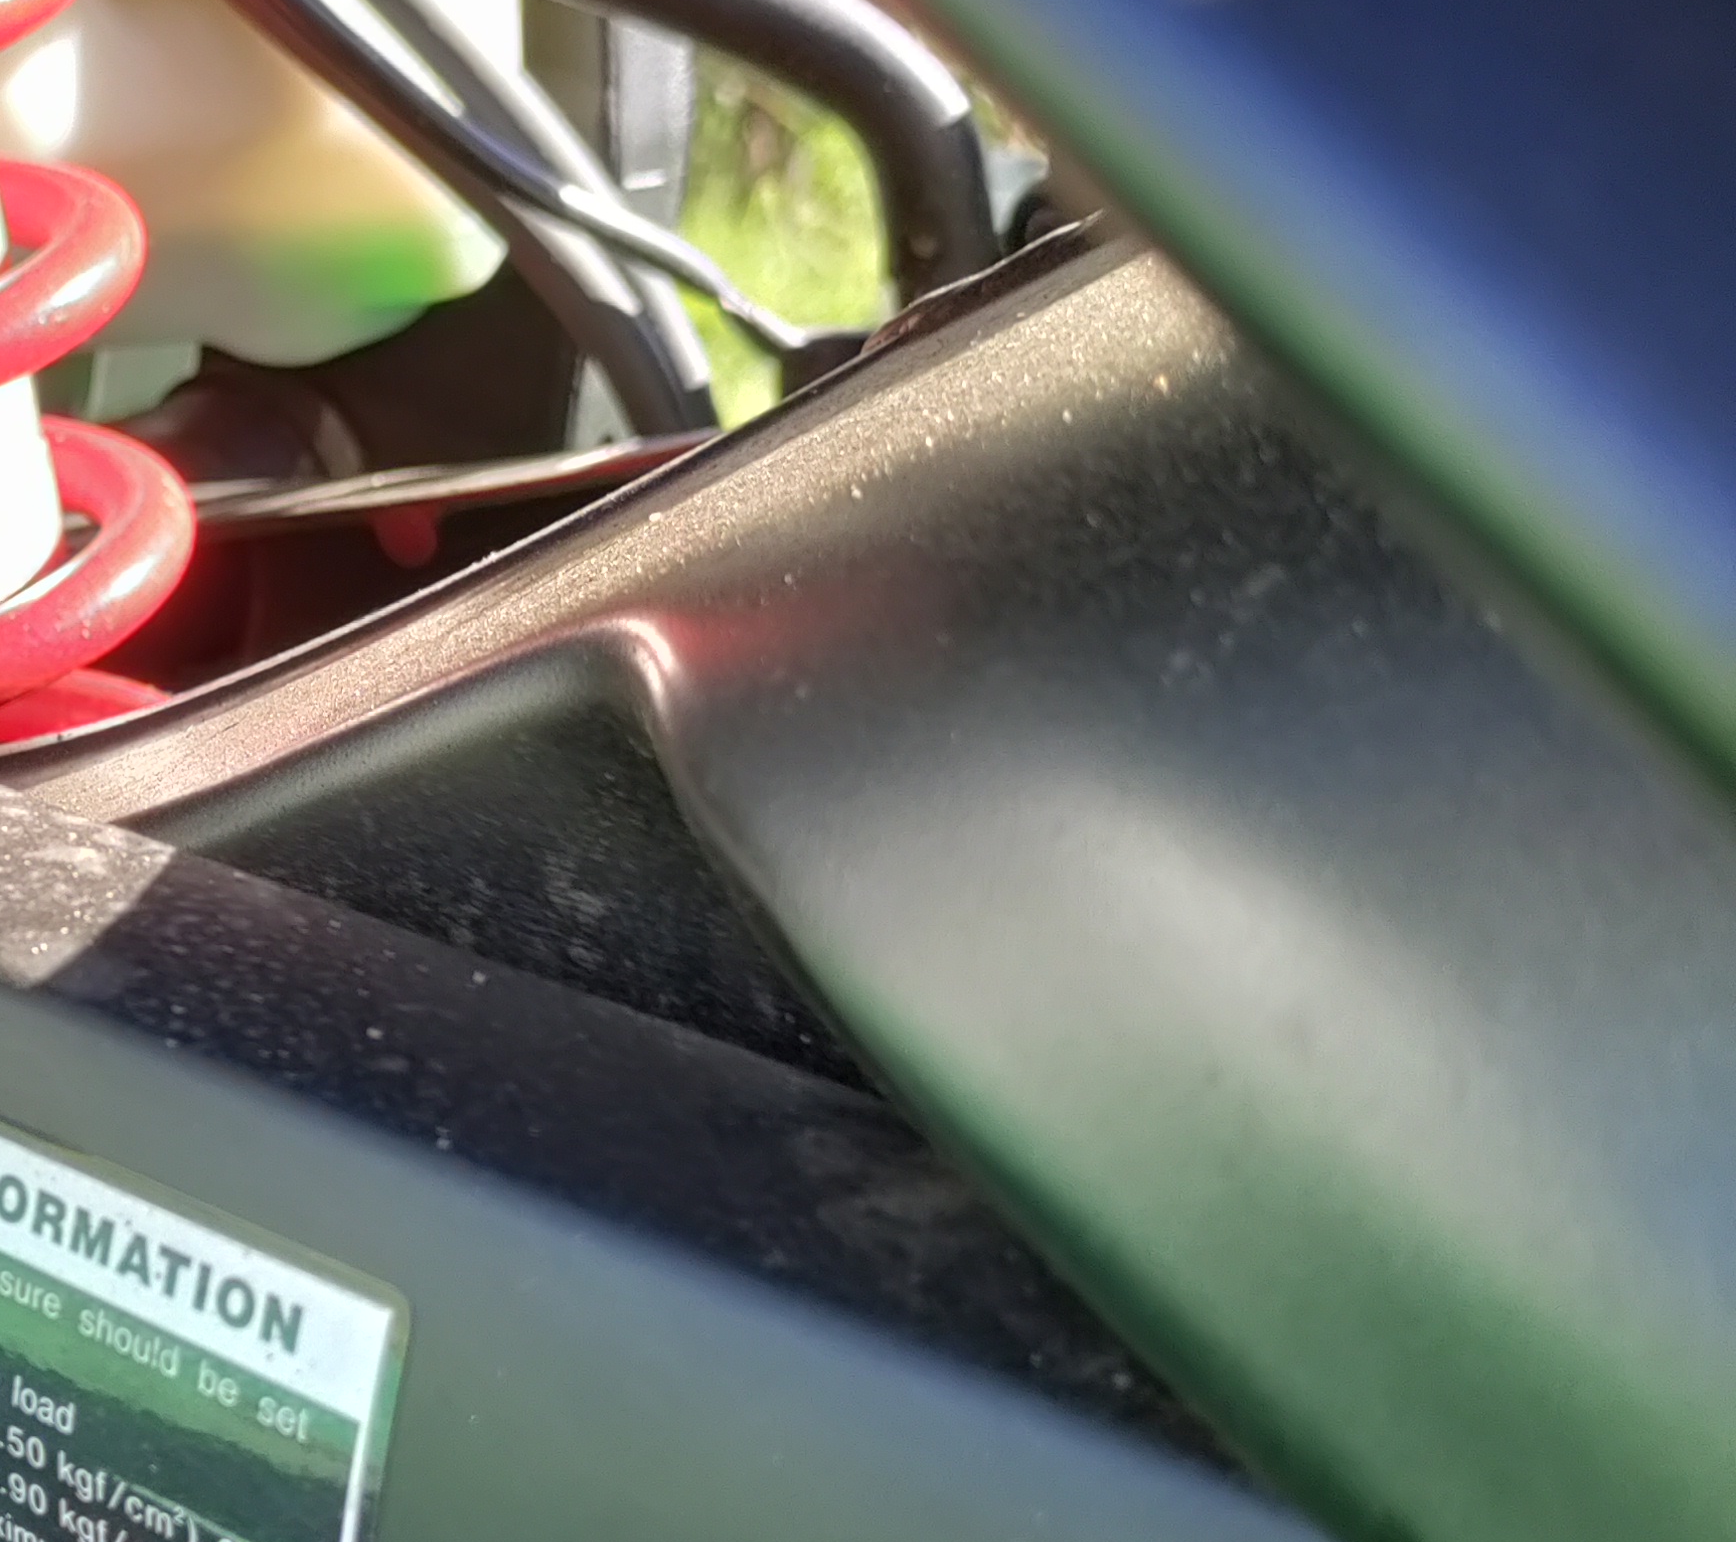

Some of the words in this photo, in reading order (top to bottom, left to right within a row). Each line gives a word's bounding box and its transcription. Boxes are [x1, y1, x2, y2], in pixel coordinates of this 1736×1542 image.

[12, 1375, 76, 1436] load
[78, 1308, 181, 1380] should
[198, 1359, 239, 1408] be
[256, 1396, 310, 1444] set
